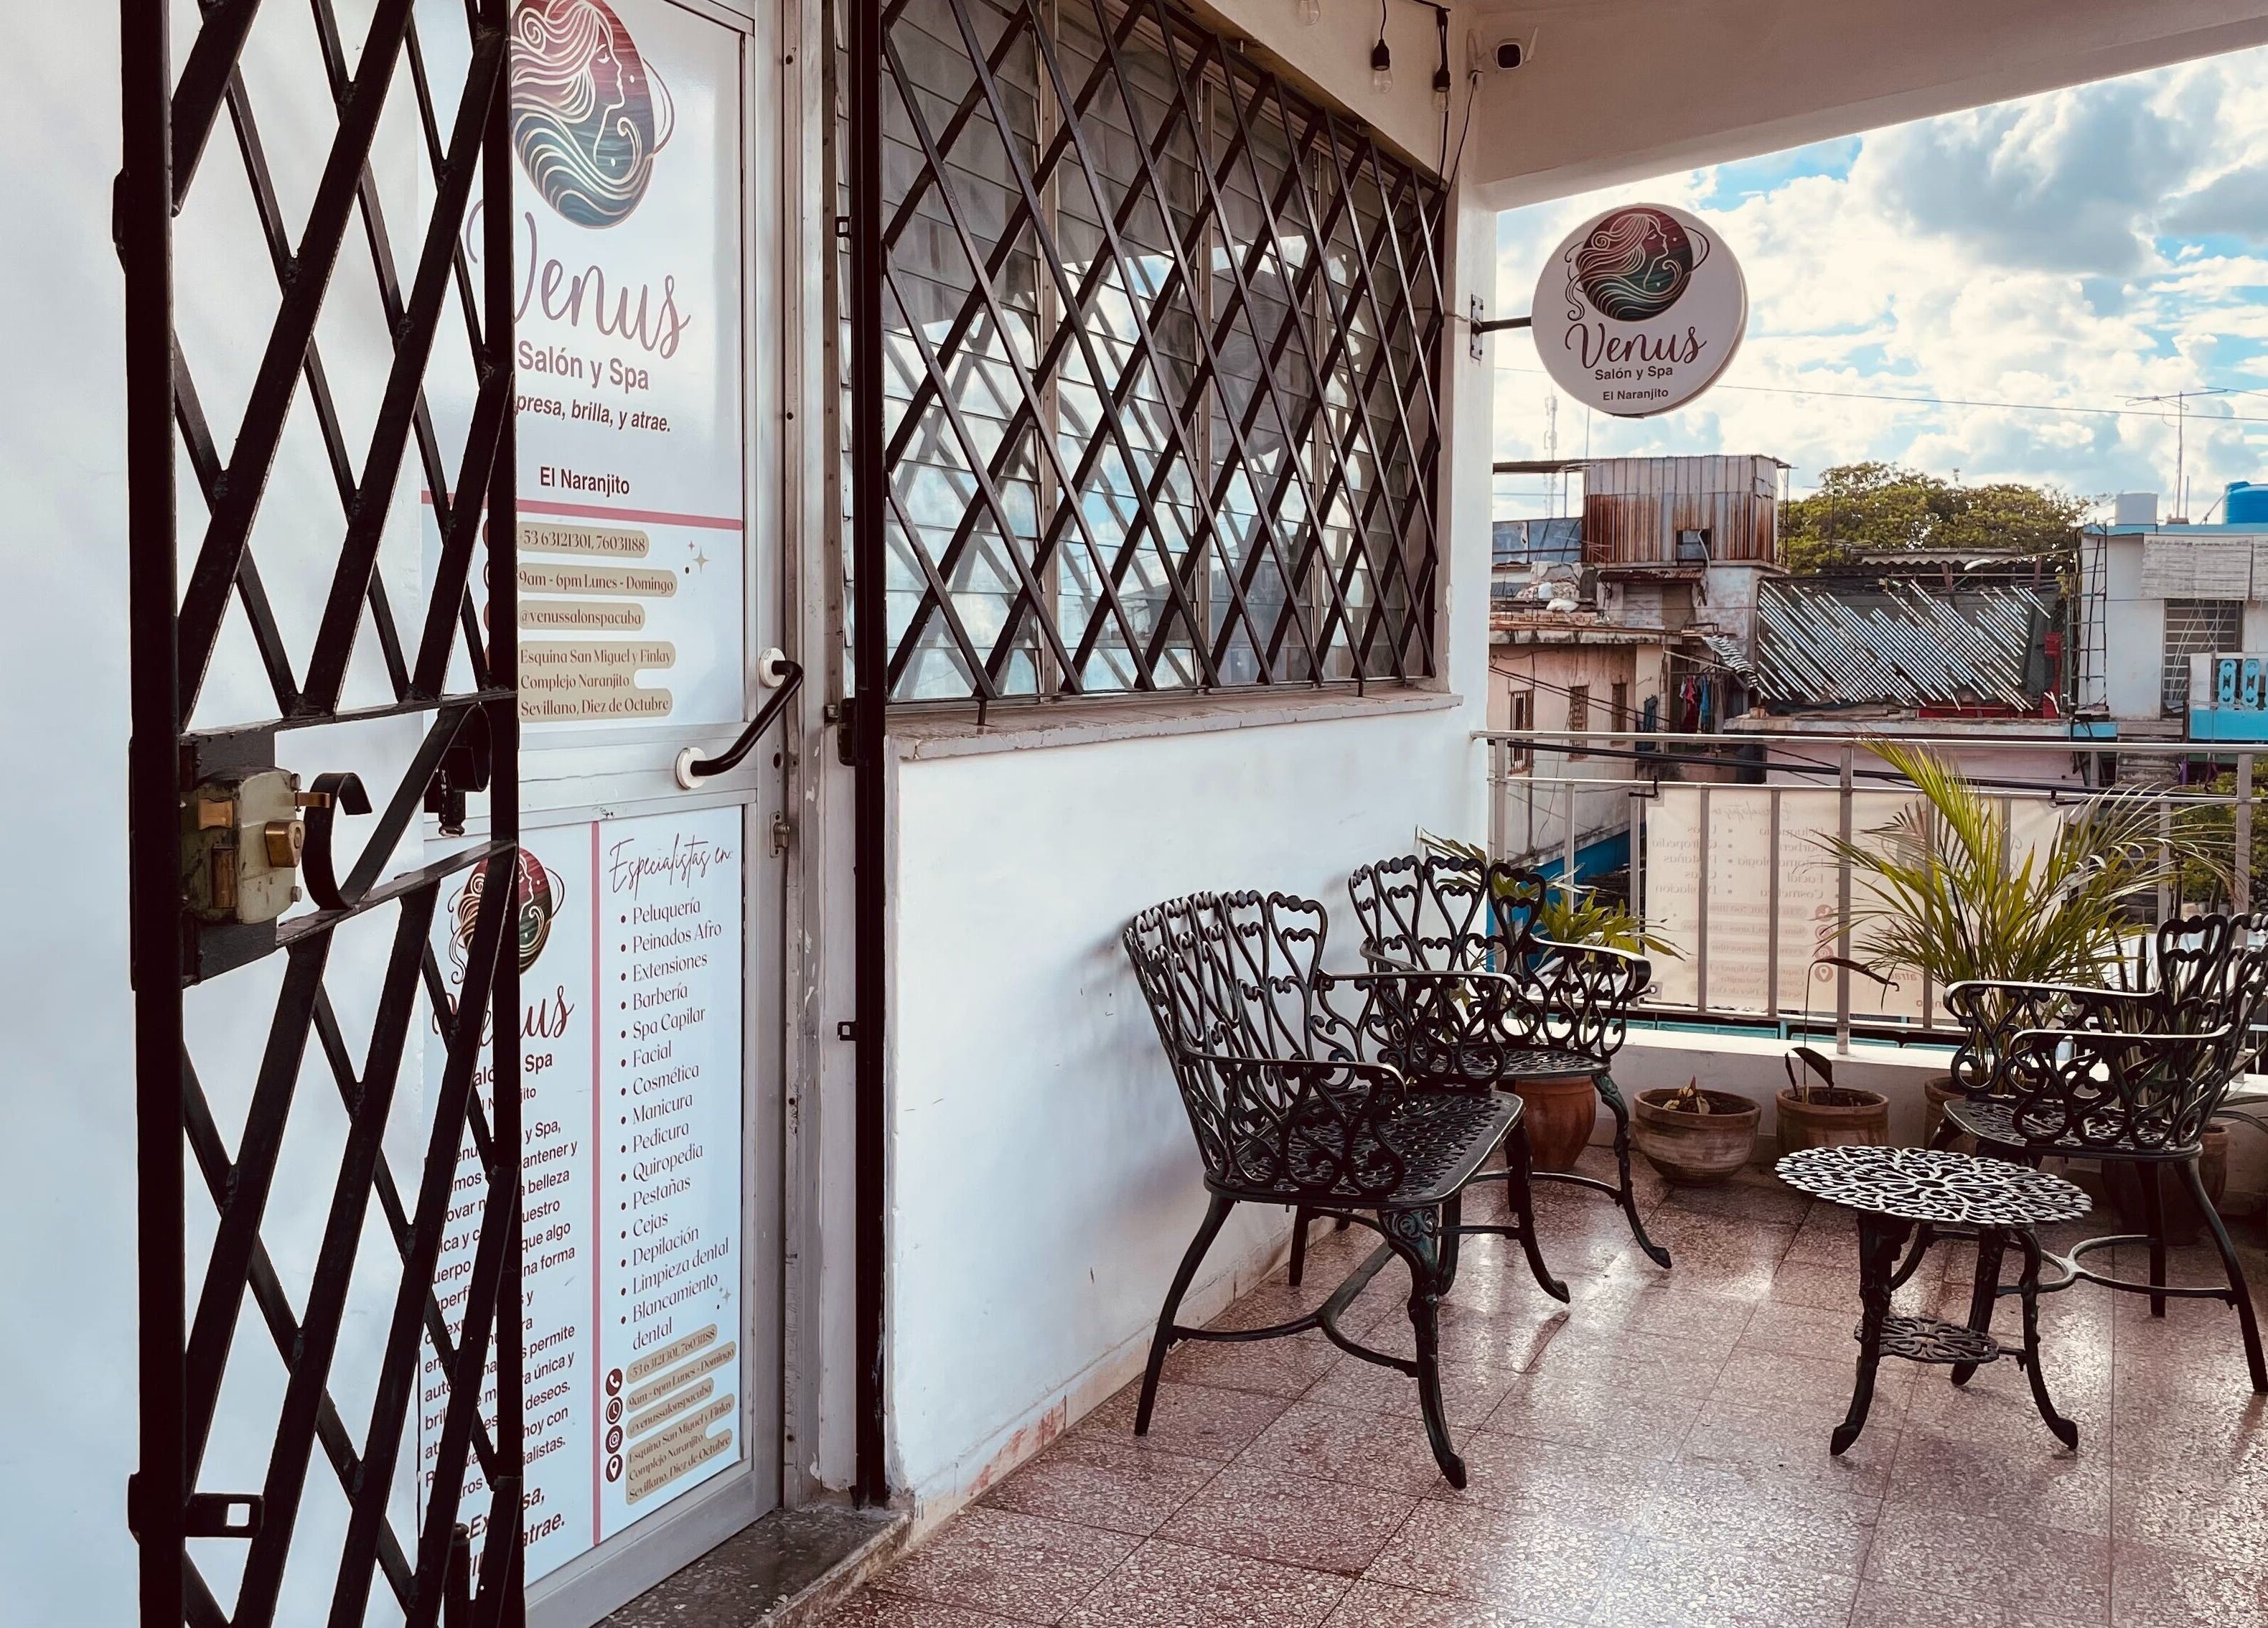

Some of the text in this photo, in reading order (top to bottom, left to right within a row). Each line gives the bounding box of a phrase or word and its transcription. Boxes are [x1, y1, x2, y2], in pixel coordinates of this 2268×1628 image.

[1565, 323, 1707, 369] Venus
[518, 340, 649, 393] Salón y Spa
[1595, 365, 1673, 380] Salón y Spa
[1603, 388, 1669, 401] El Naranjito
[515, 395, 670, 431] presa, brilla, y atrae.
[540, 467, 629, 497] El Naranjito
[519, 571, 546, 586] 9am
[556, 574, 582, 590] 6pm
[584, 574, 617, 589] Lunes
[627, 576, 673, 594] Domingo
[521, 609, 641, 627] @venussalonspacuba
[520, 649, 671, 666] Esquina San Miguel y Finlay
[521, 673, 629, 692] Complejo Naranjito
[521, 696, 669, 716] Sevillano, Diez de Octubre
[609, 833, 711, 901] Especialistas
[633, 897, 700, 925] Peluquería
[633, 920, 722, 953] Peinados Afro
[633, 953, 708, 982] Extensiones
[633, 982, 688, 1011] Barbería
[633, 1007, 706, 1041] Spa Capilar
[525, 1052, 553, 1075] Spa
[633, 1040, 672, 1067] Facial
[633, 1065, 699, 1095] Cosmética
[633, 1094, 693, 1125] Manicura
[525, 1128, 533, 1144] y
[535, 1121, 561, 1138] Spa,
[633, 1122, 689, 1153] Pedicura
[523, 1141, 577, 1169] antener y
[633, 1143, 703, 1182] Quiropedia
[528, 1170, 569, 1194] belleza
[633, 1176, 690, 1210] Pestañas
[462, 1232, 469, 1249] y
[523, 1199, 561, 1223] uestro
[633, 1213, 668, 1237] Cejas
[434, 1260, 471, 1284] uerpo
[545, 1222, 571, 1241] algo
[540, 1247, 575, 1271] forma
[633, 1226, 698, 1266] Depilación
[633, 1237, 728, 1294] Limpieza dental
[527, 1290, 533, 1306] y
[633, 1273, 718, 1323] Blancamiento
[530, 1326, 574, 1359] permite
[633, 1316, 672, 1350] dental
[535, 1356, 565, 1380] única
[568, 1352, 574, 1368] y
[672, 1369, 695, 1387] Lunes
[525, 1381, 570, 1411] deseos.
[547, 1408, 568, 1426] con
[662, 1431, 678, 1442] San
[688, 1453, 697, 1466] de
[698, 1437, 731, 1457] Octubre
[629, 1453, 667, 1481] Complejo
